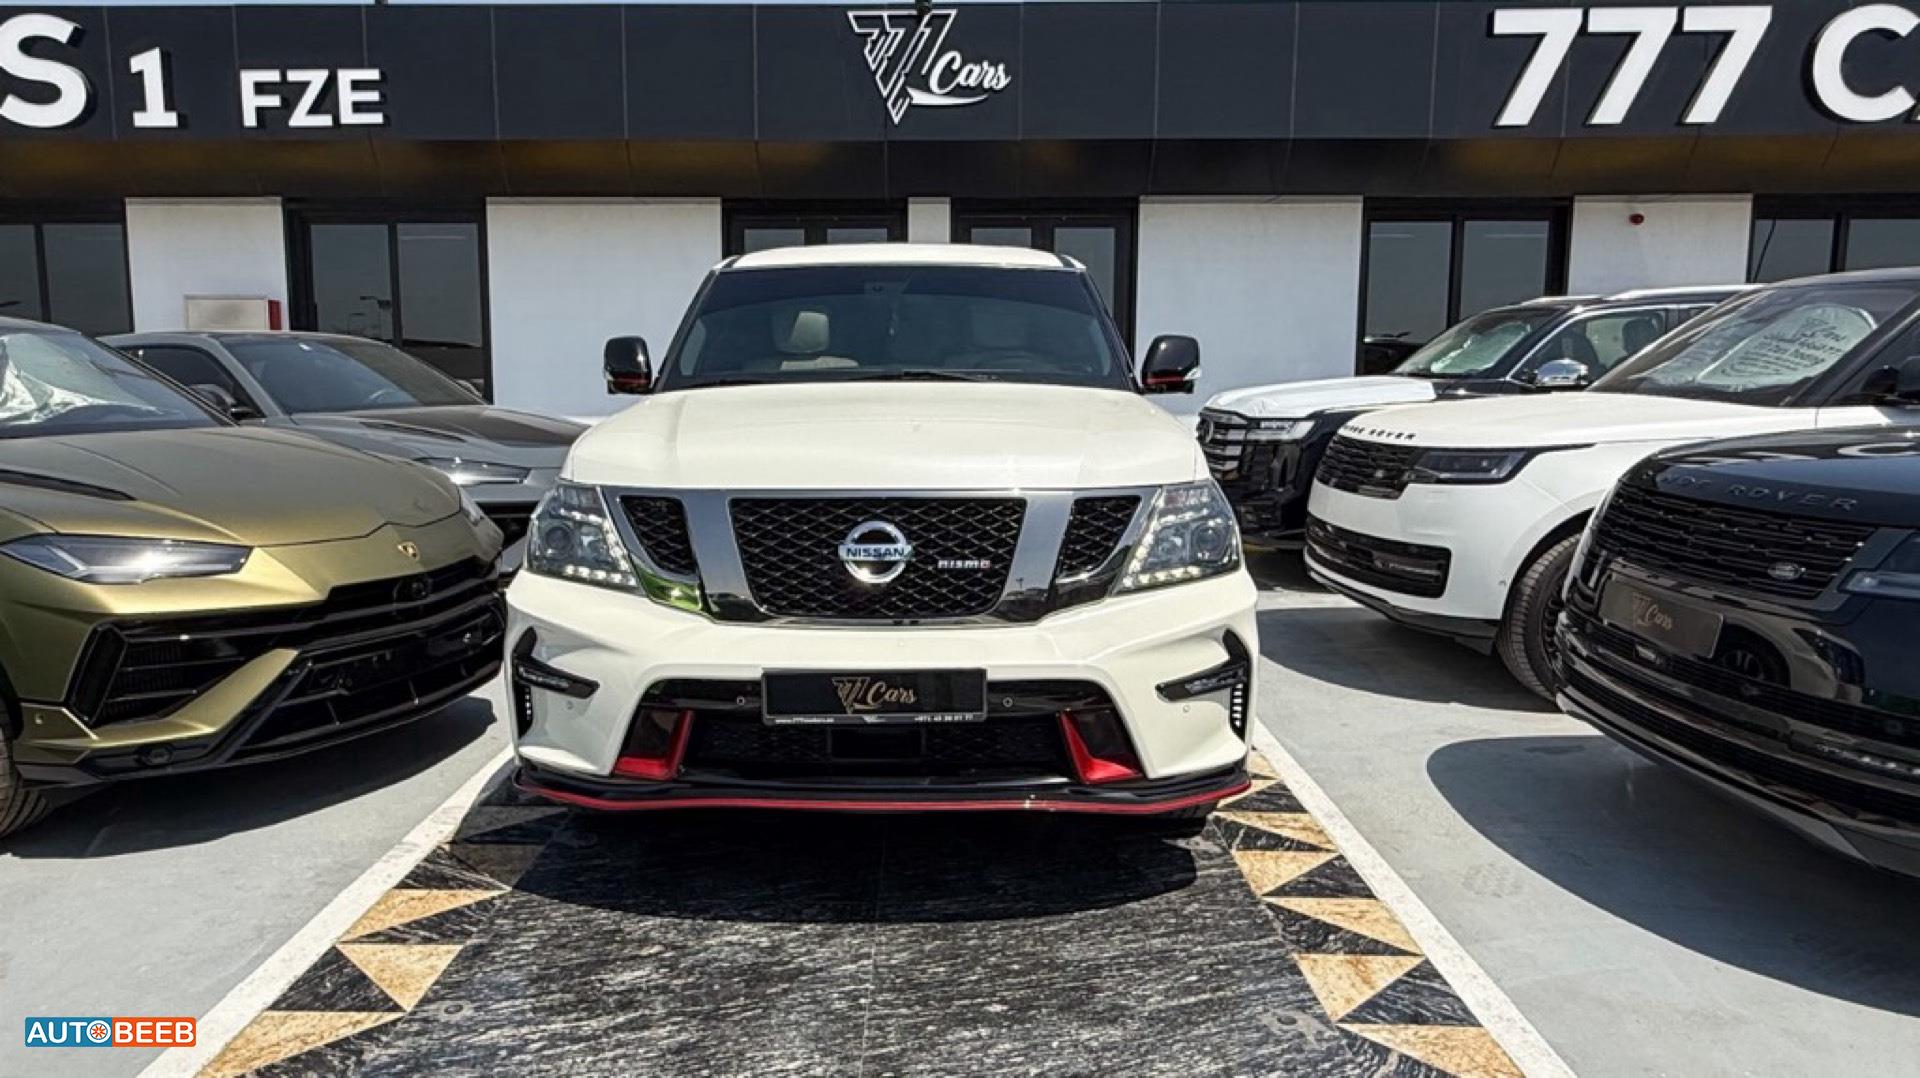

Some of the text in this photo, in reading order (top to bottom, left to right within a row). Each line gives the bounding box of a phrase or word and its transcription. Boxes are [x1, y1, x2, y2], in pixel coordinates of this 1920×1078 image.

[930, 50, 1012, 94] Cars
[1493, 3, 1920, 126] 777 C
[129, 47, 178, 127] 1
[240, 68, 384, 128] FZE
[846, 547, 905, 558] NISSAN
[868, 681, 917, 705] Cars
